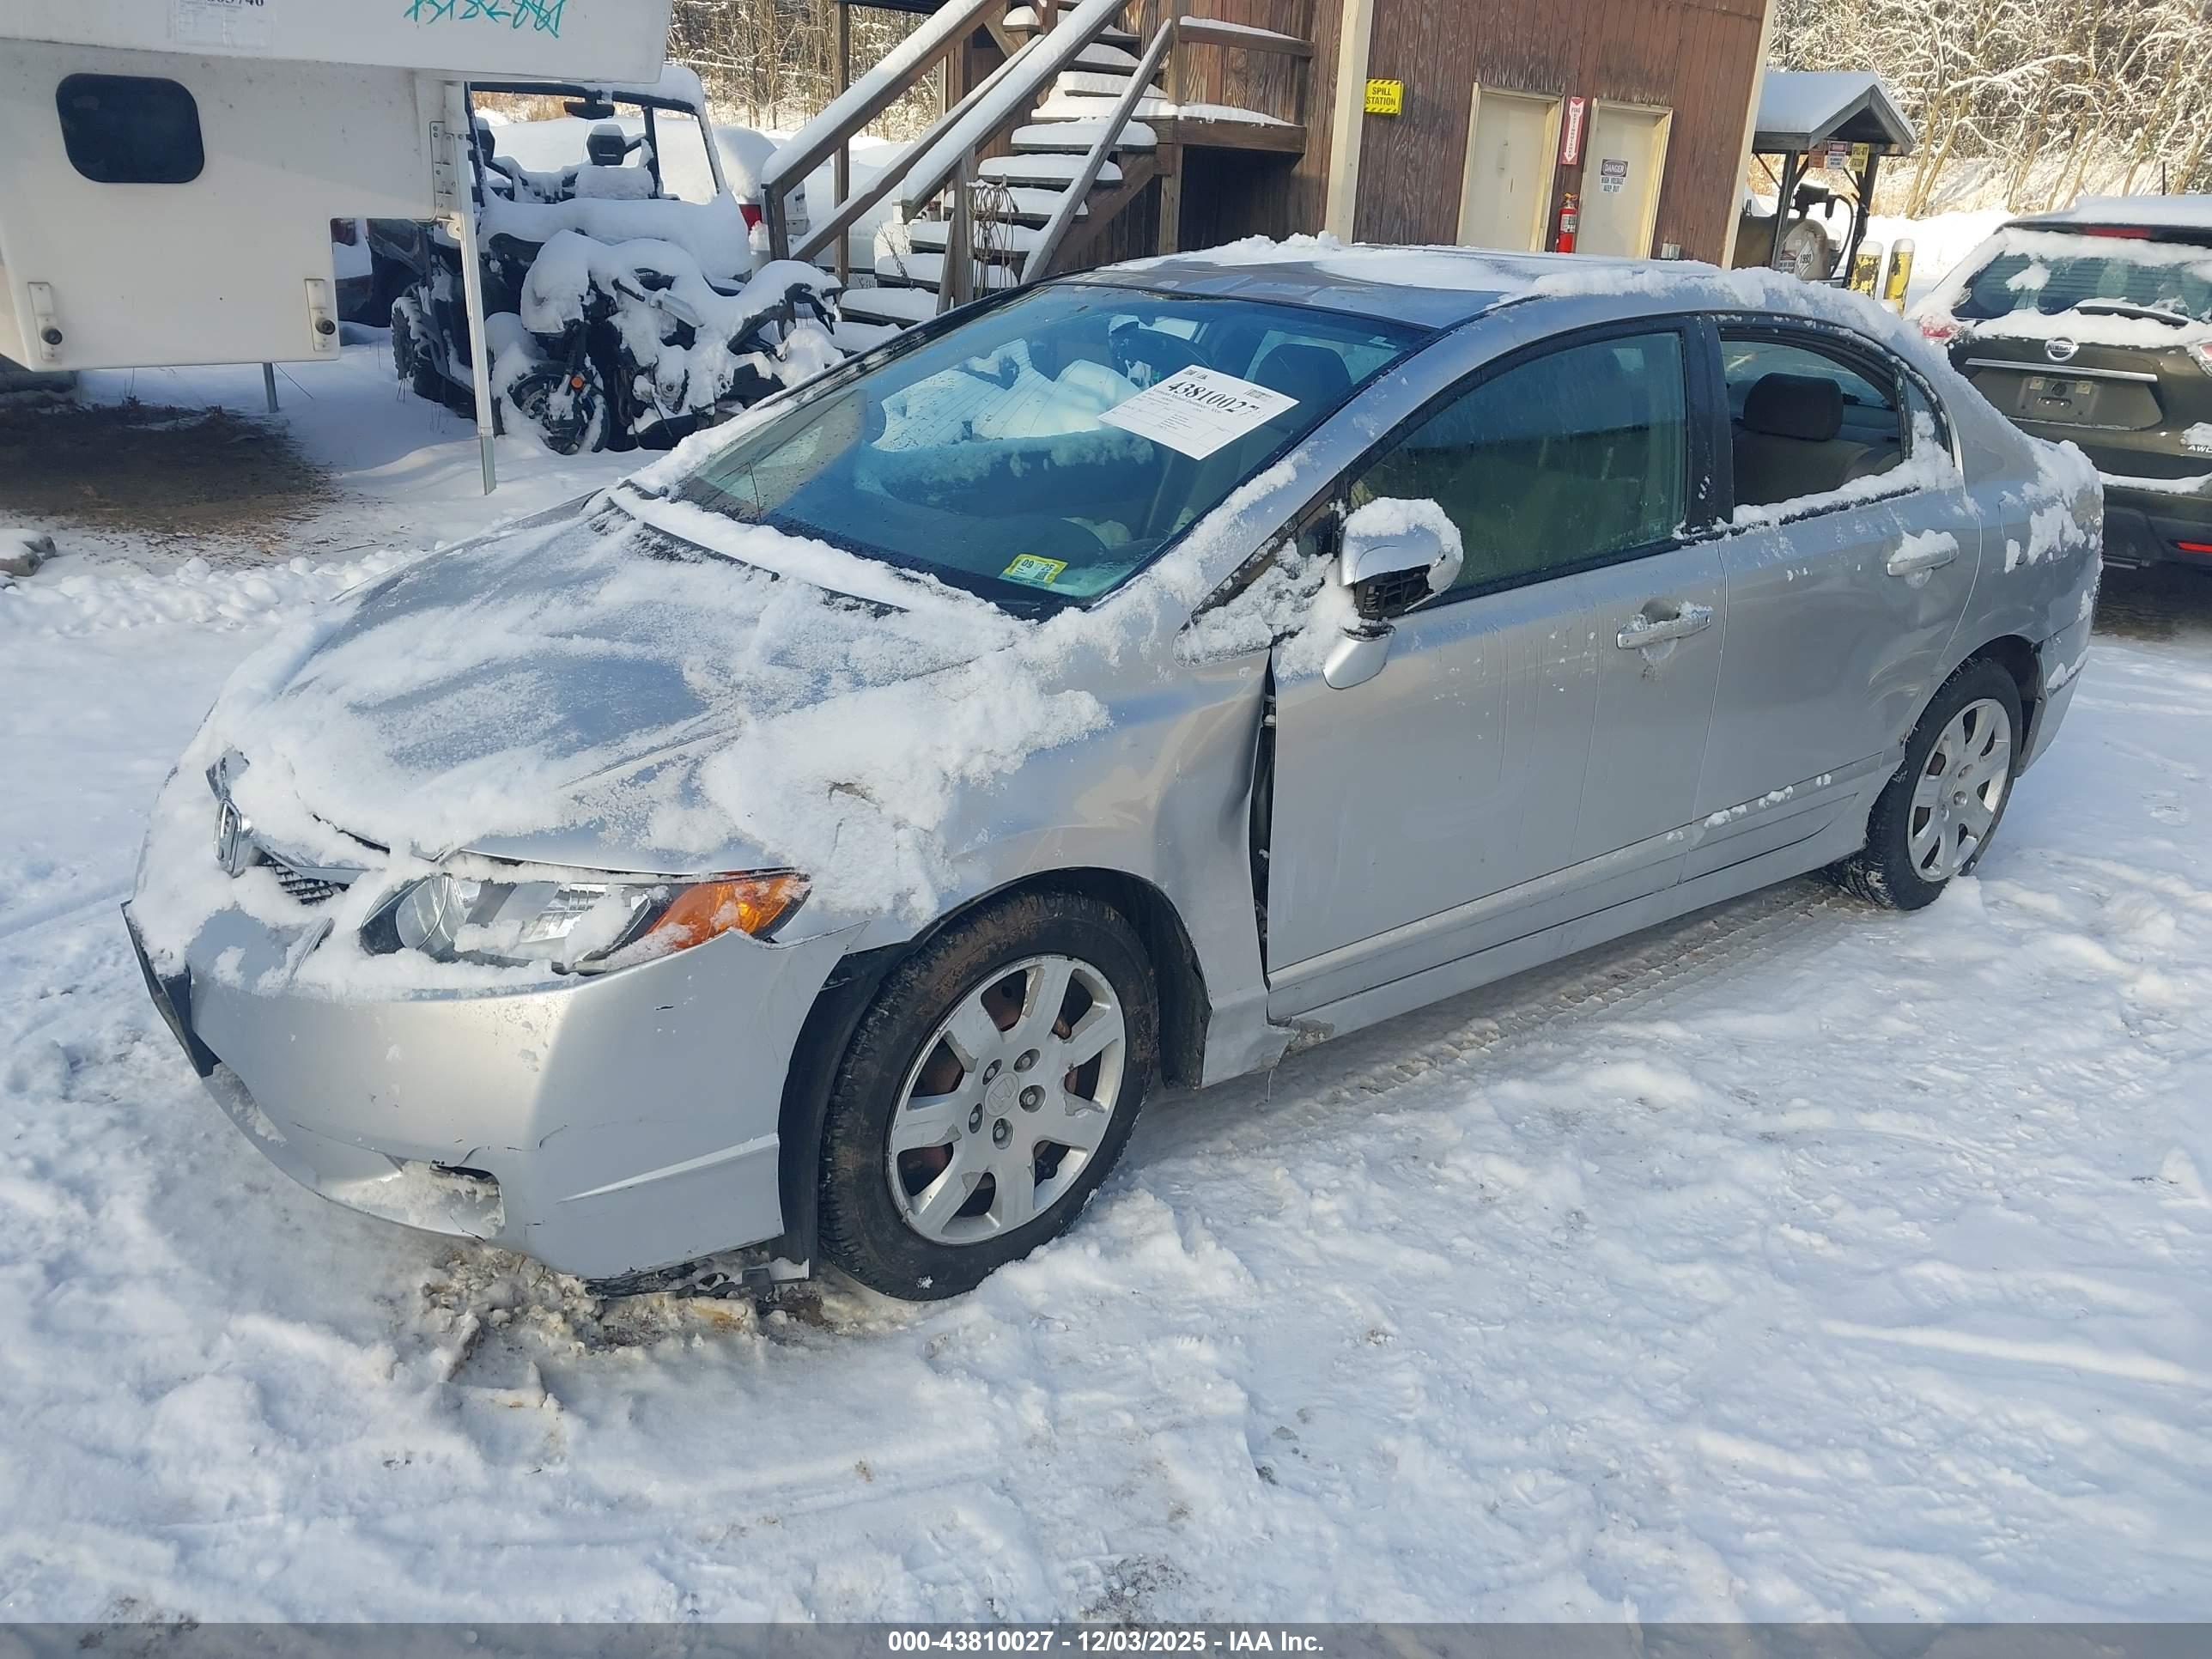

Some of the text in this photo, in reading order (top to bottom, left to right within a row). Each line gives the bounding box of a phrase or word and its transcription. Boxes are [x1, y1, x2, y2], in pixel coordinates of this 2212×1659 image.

[1372, 87, 1391, 95] SPILL
[1366, 96, 1396, 106] STATION
[1604, 164, 1624, 173] DANGER
[1021, 559, 1054, 571] 09 25
